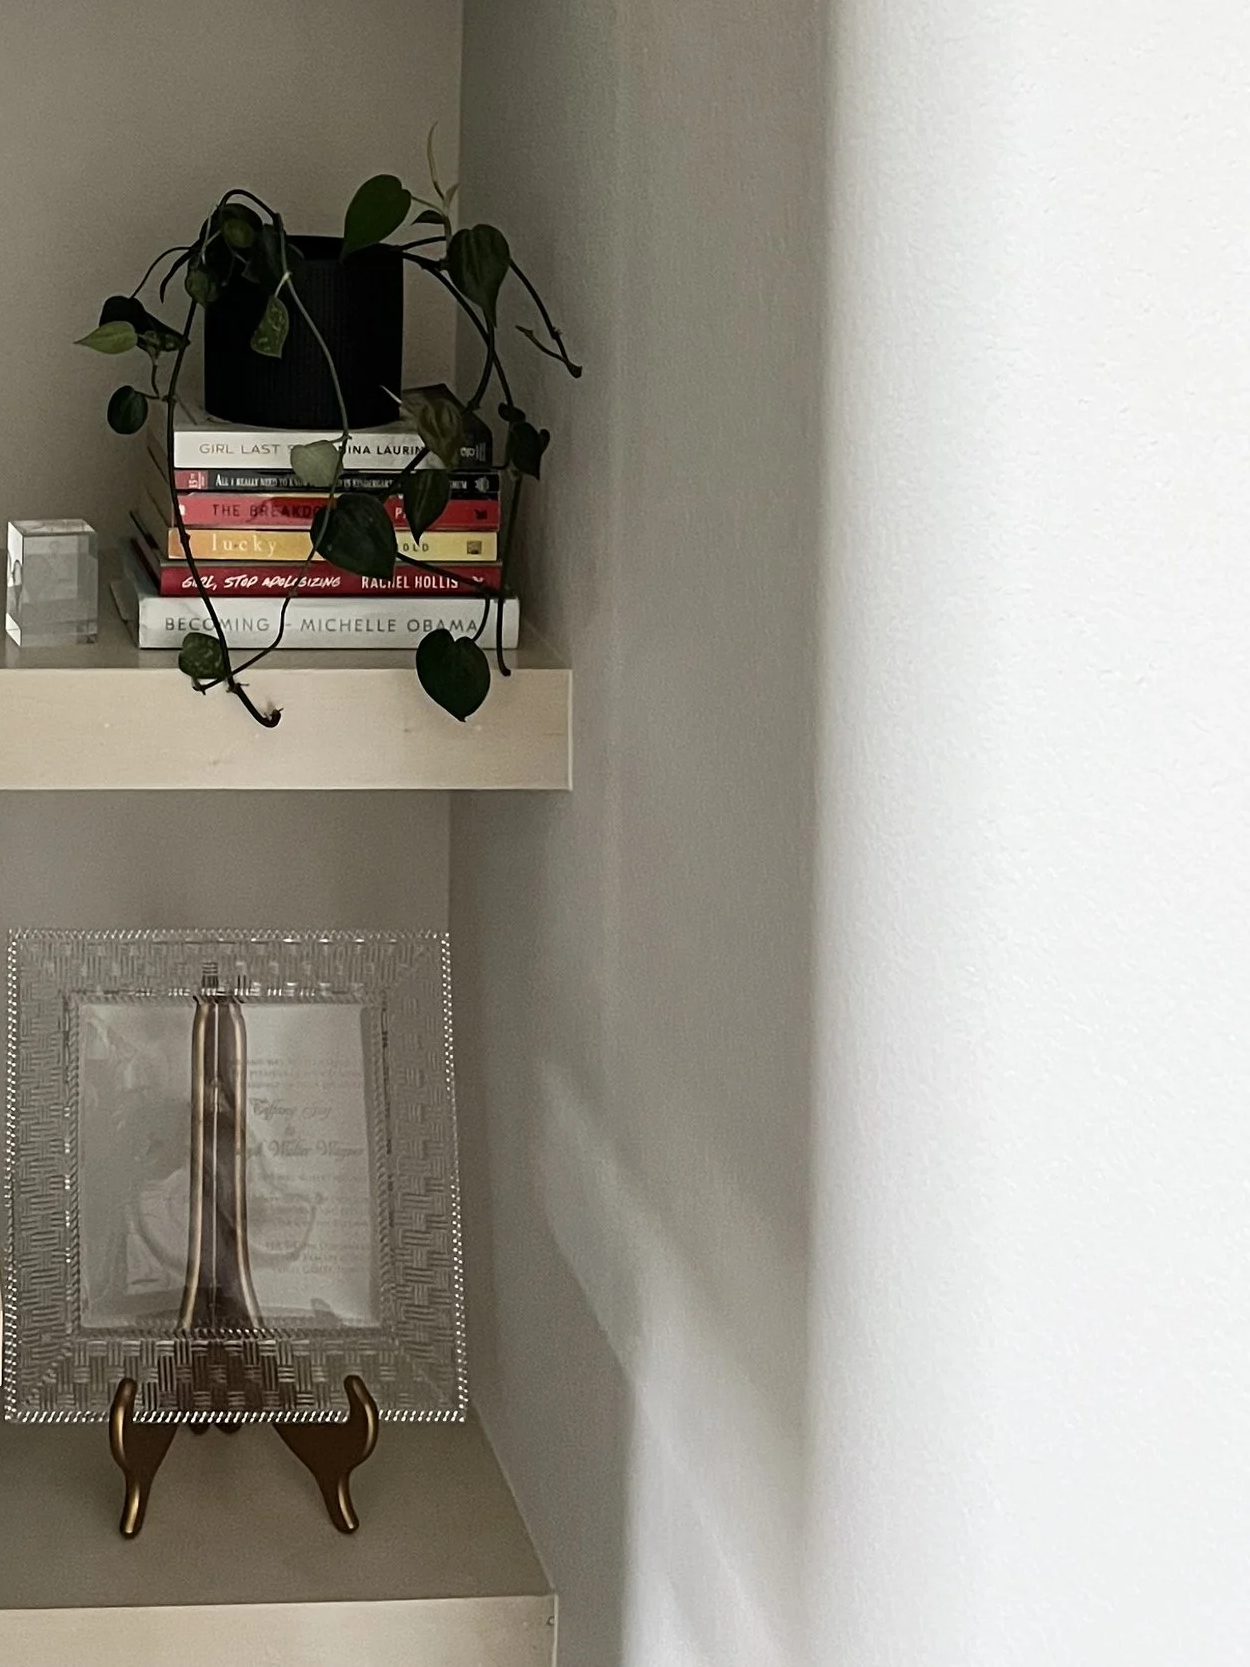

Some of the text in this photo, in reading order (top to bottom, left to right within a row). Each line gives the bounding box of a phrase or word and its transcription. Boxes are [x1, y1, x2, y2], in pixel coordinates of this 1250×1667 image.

[200, 443, 234, 454] GIRL
[241, 444, 281, 454] LAST
[376, 445, 423, 455] LAURIN
[352, 478, 393, 488] KINDERGART
[212, 504, 319, 517] THE BREAKD
[212, 534, 277, 558] lucky
[224, 574, 259, 589] STOP
[414, 575, 459, 589] HOLLIS
[165, 617, 270, 632] BECOMING
[300, 618, 396, 633] MICHELLE
[406, 619, 478, 633] OBAMA
